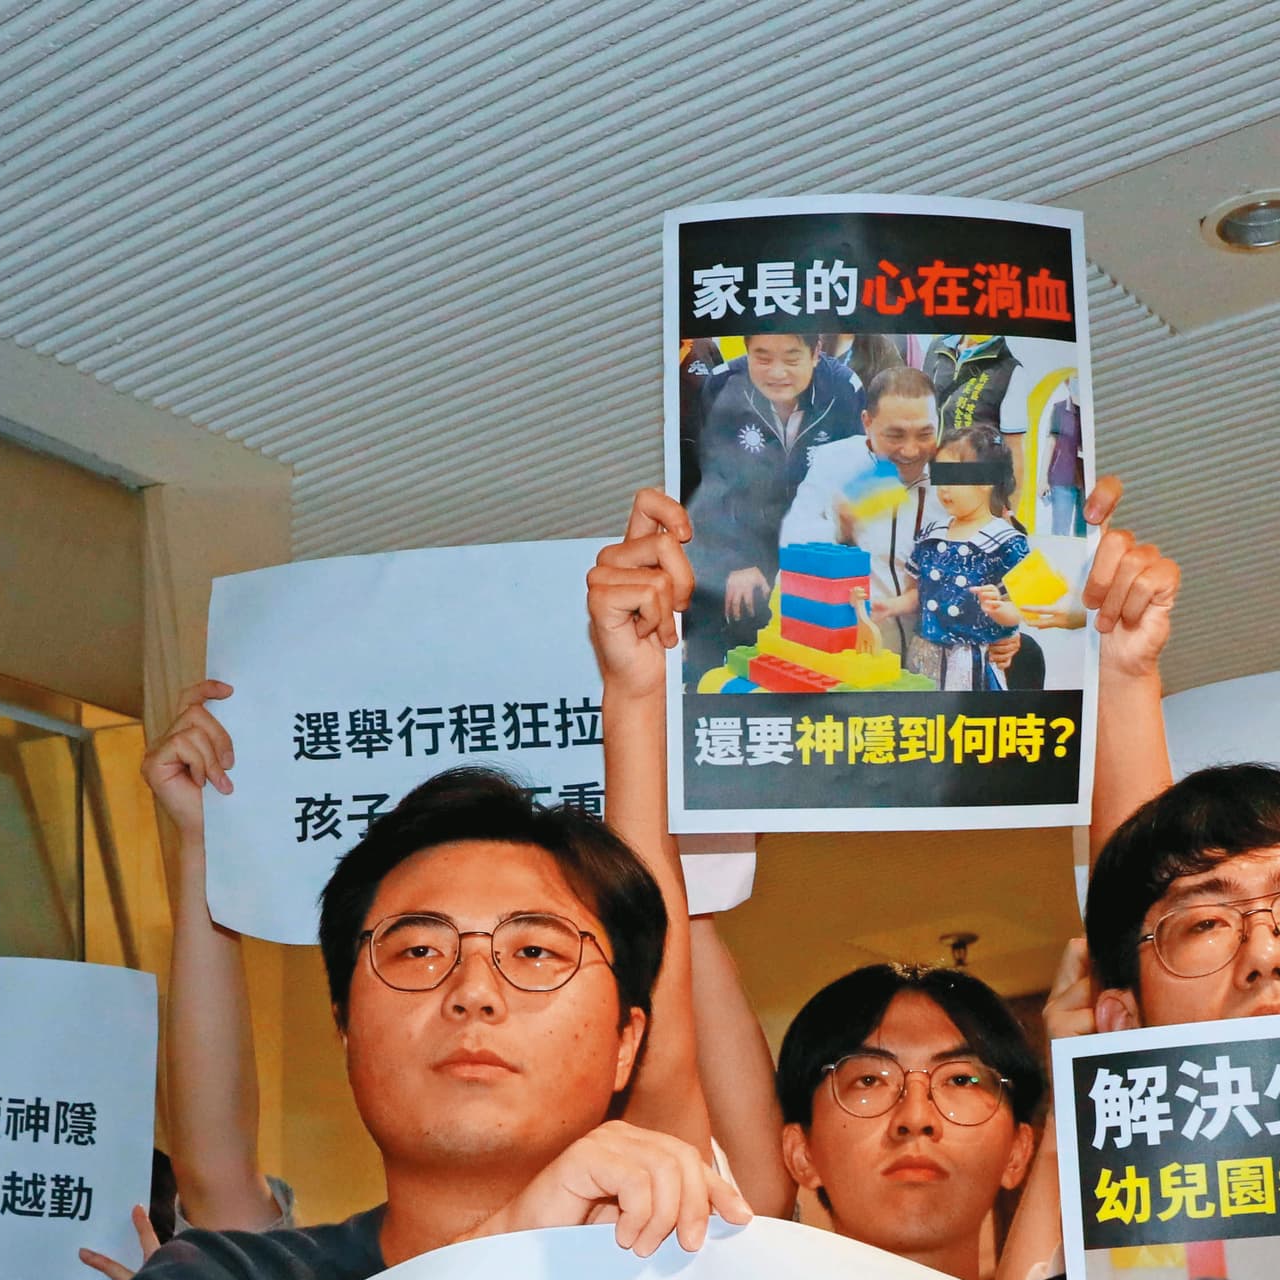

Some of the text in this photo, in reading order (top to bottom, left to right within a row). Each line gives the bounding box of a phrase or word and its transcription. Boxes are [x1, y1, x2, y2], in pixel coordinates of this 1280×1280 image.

[693, 258, 1071, 322] 家長的心在淌血
[293, 697, 604, 761] 選舉行程狂拉
[695, 714, 1076, 765] 還要神隱到何時?
